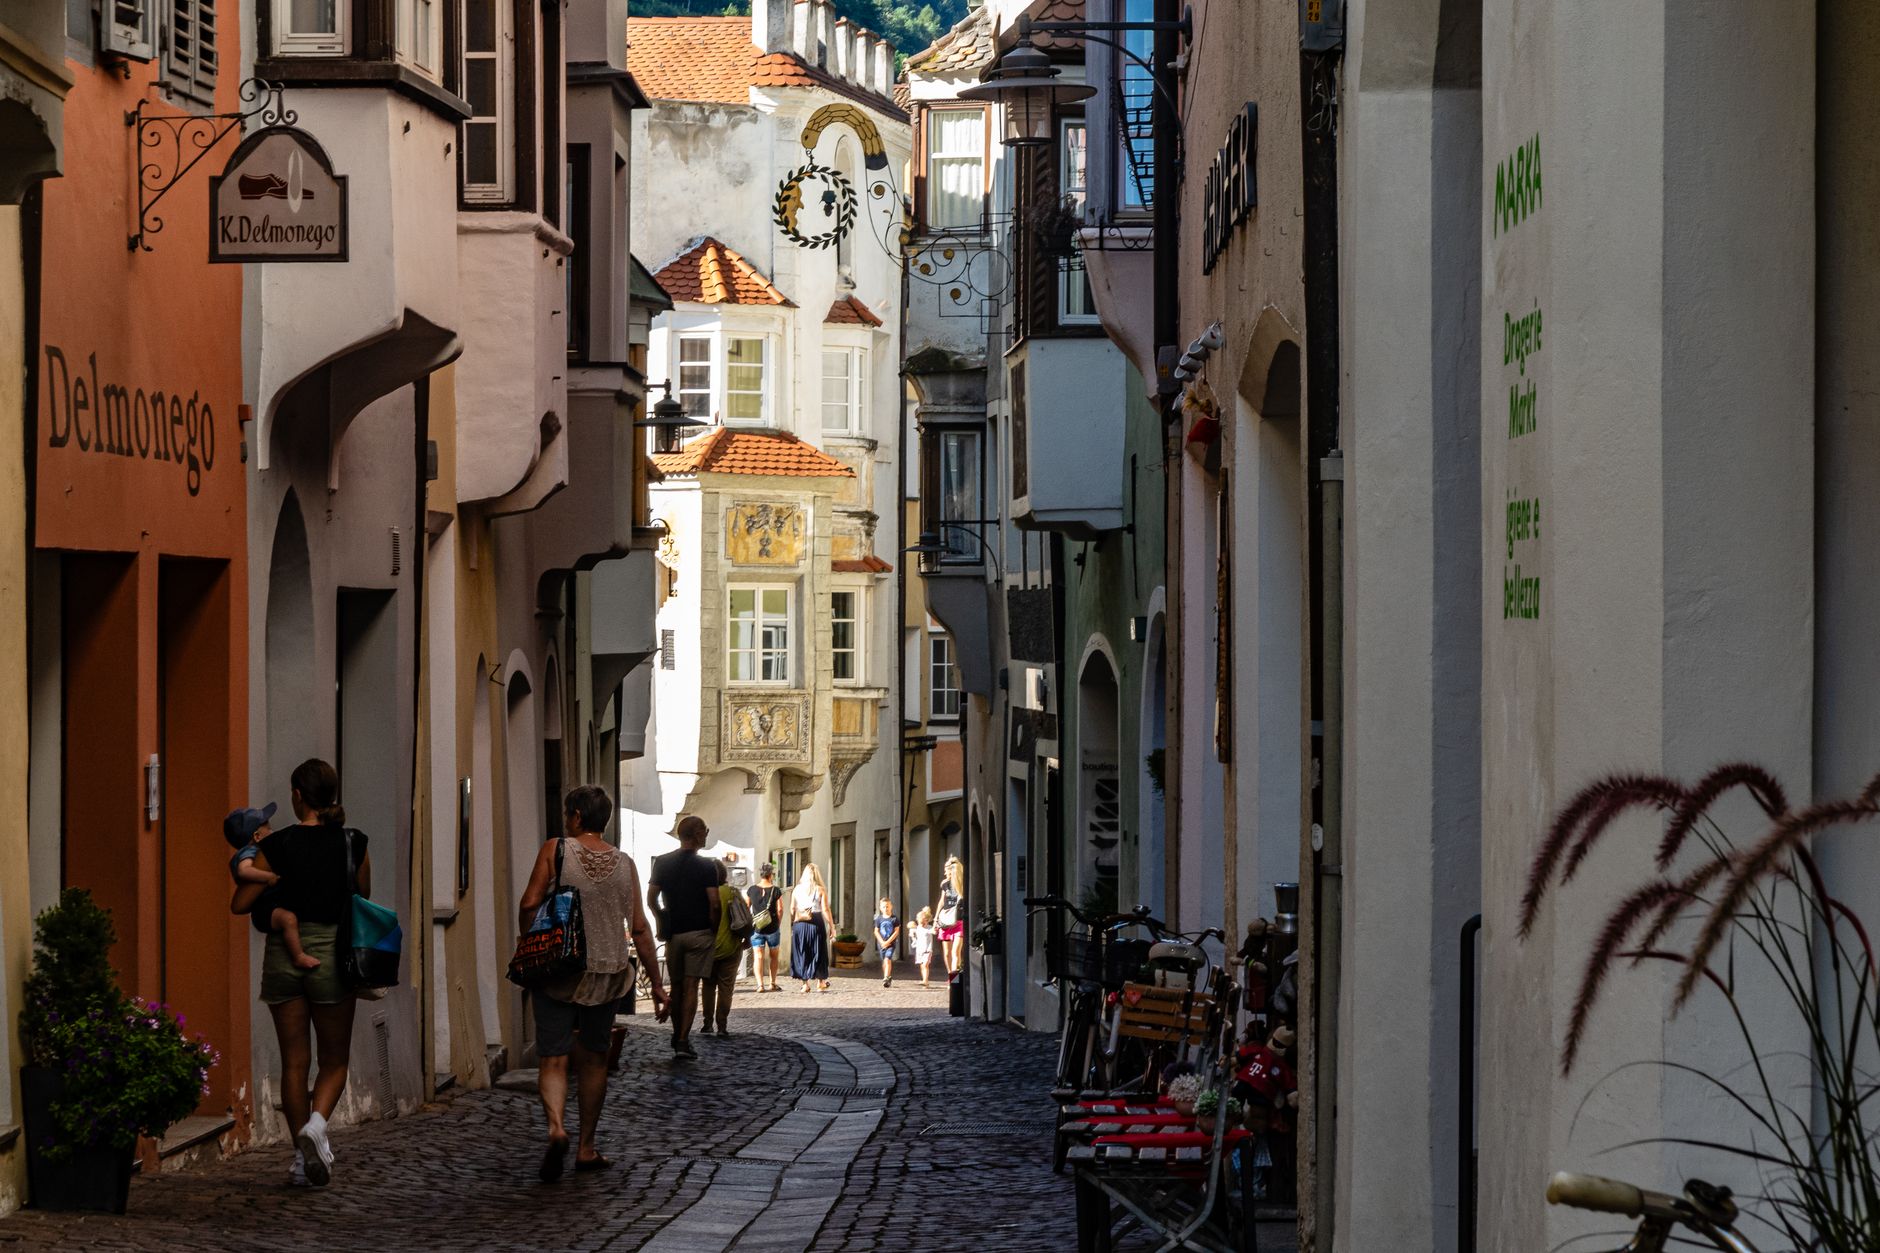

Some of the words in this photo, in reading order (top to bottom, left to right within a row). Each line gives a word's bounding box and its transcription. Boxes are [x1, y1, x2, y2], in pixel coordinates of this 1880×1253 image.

[1494, 131, 1542, 240] MARKA
[1504, 296, 1542, 376] Drogerie
[45, 345, 214, 497] Delmonego
[1508, 378, 1537, 440] Markt
[1533, 497, 1540, 539] e
[1503, 564, 1540, 620] bellezza
